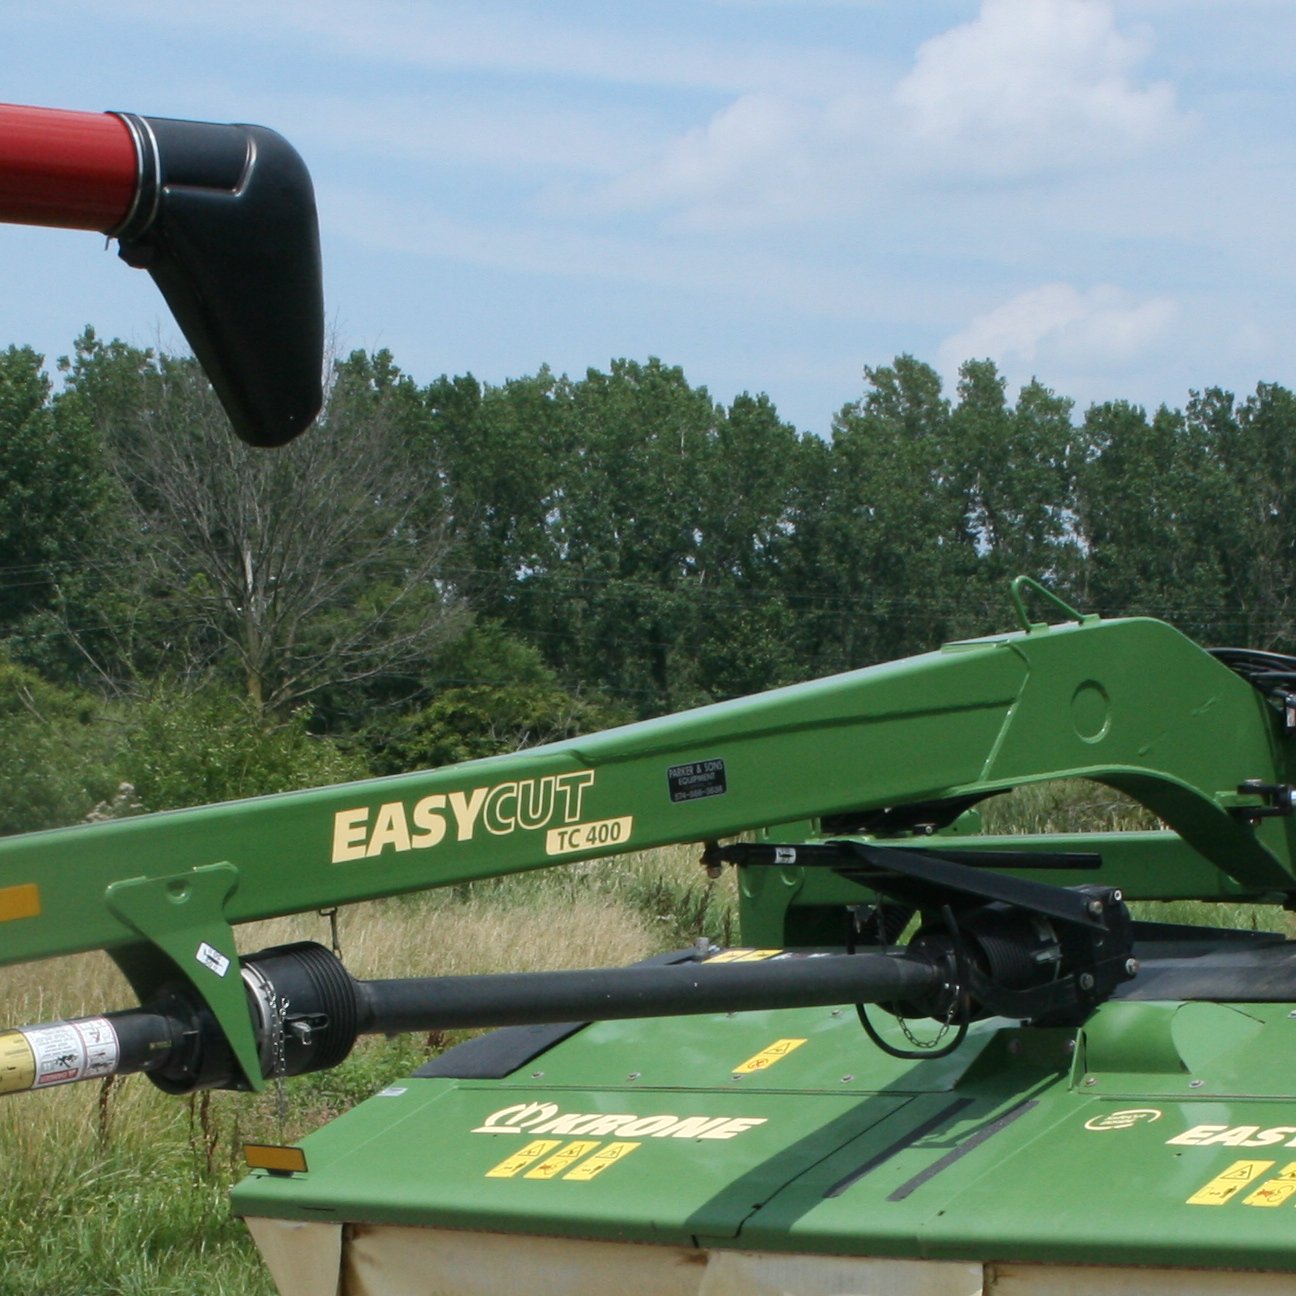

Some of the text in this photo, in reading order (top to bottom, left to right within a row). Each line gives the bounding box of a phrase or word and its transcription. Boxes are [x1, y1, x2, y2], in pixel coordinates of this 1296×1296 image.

[332, 769, 595, 864] EASYCUT
[557, 821, 621, 851] TC 400
[528, 1112, 769, 1140] KRONE
